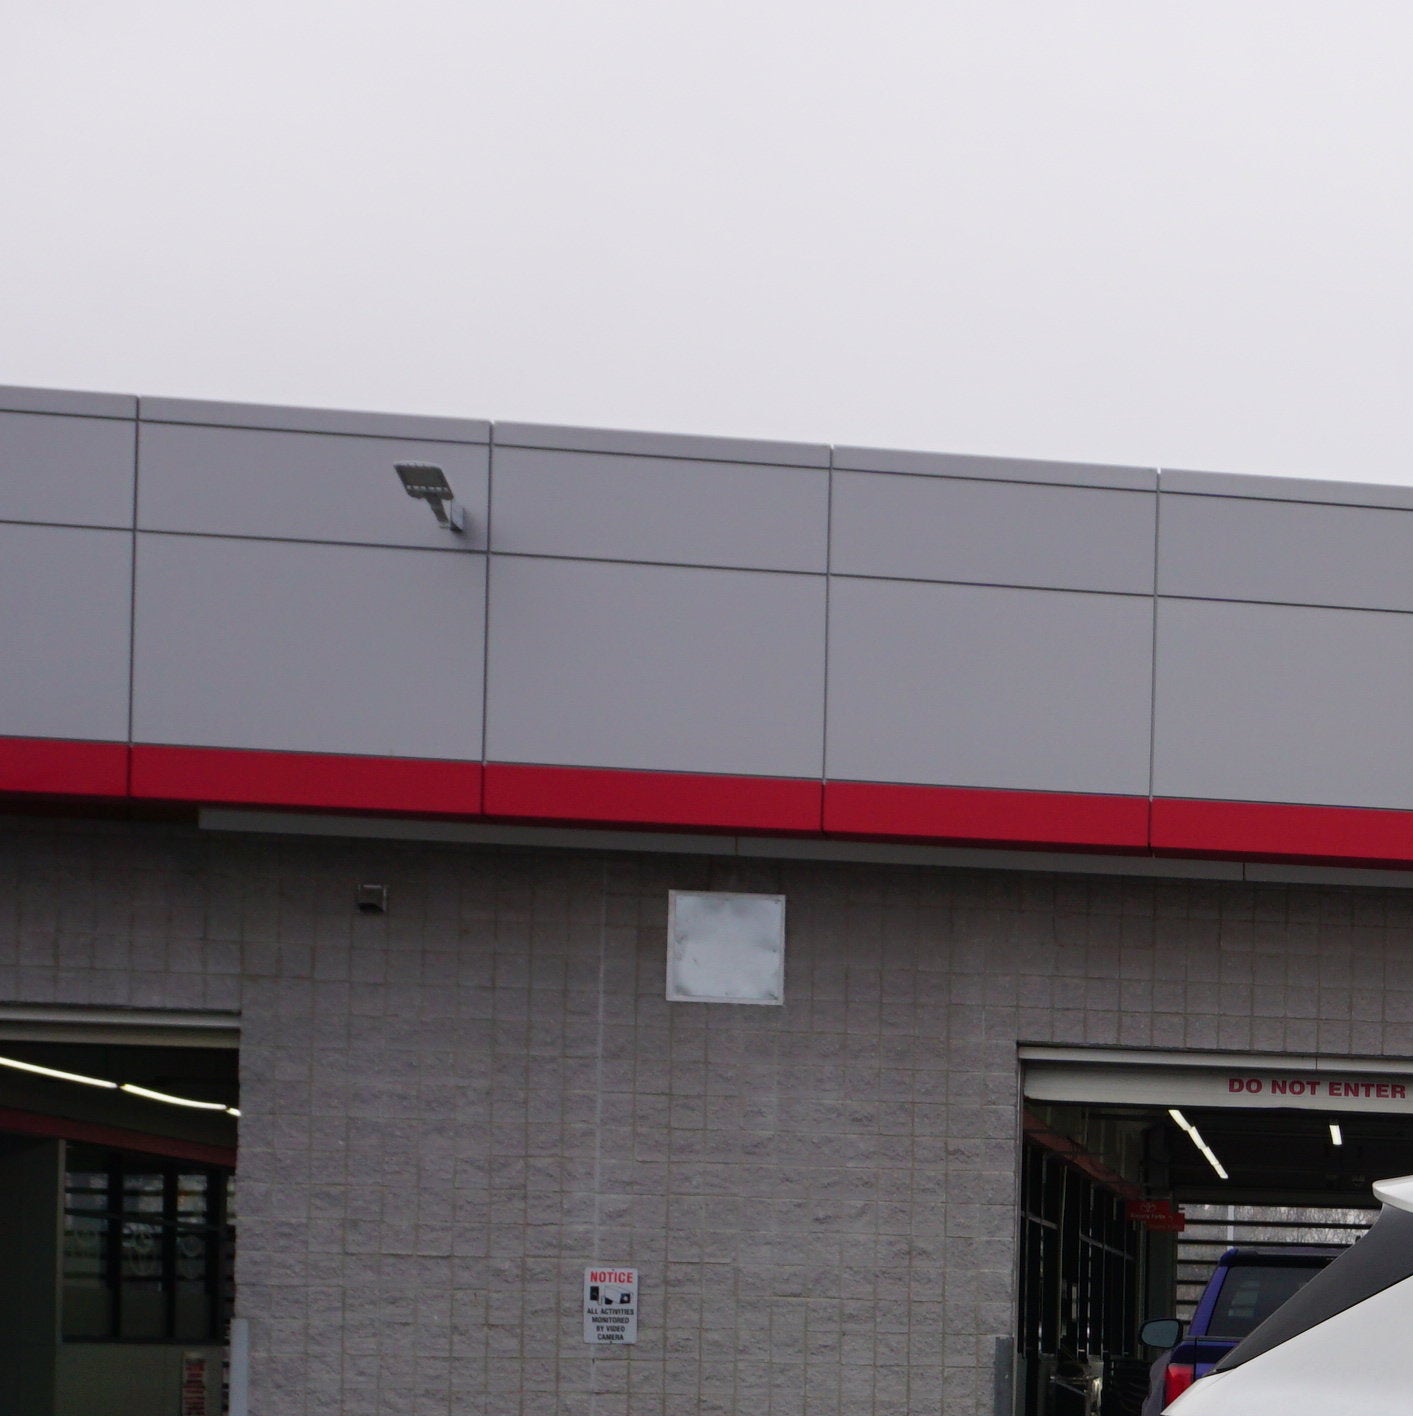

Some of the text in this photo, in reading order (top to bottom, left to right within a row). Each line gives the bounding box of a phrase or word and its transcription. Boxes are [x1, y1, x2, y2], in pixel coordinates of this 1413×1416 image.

[1228, 1078, 1406, 1099] DO NOT ENTER
[590, 1271, 633, 1284] NOTICE
[591, 1316, 630, 1324] MONITORED
[597, 1333, 624, 1341] CAMERA
